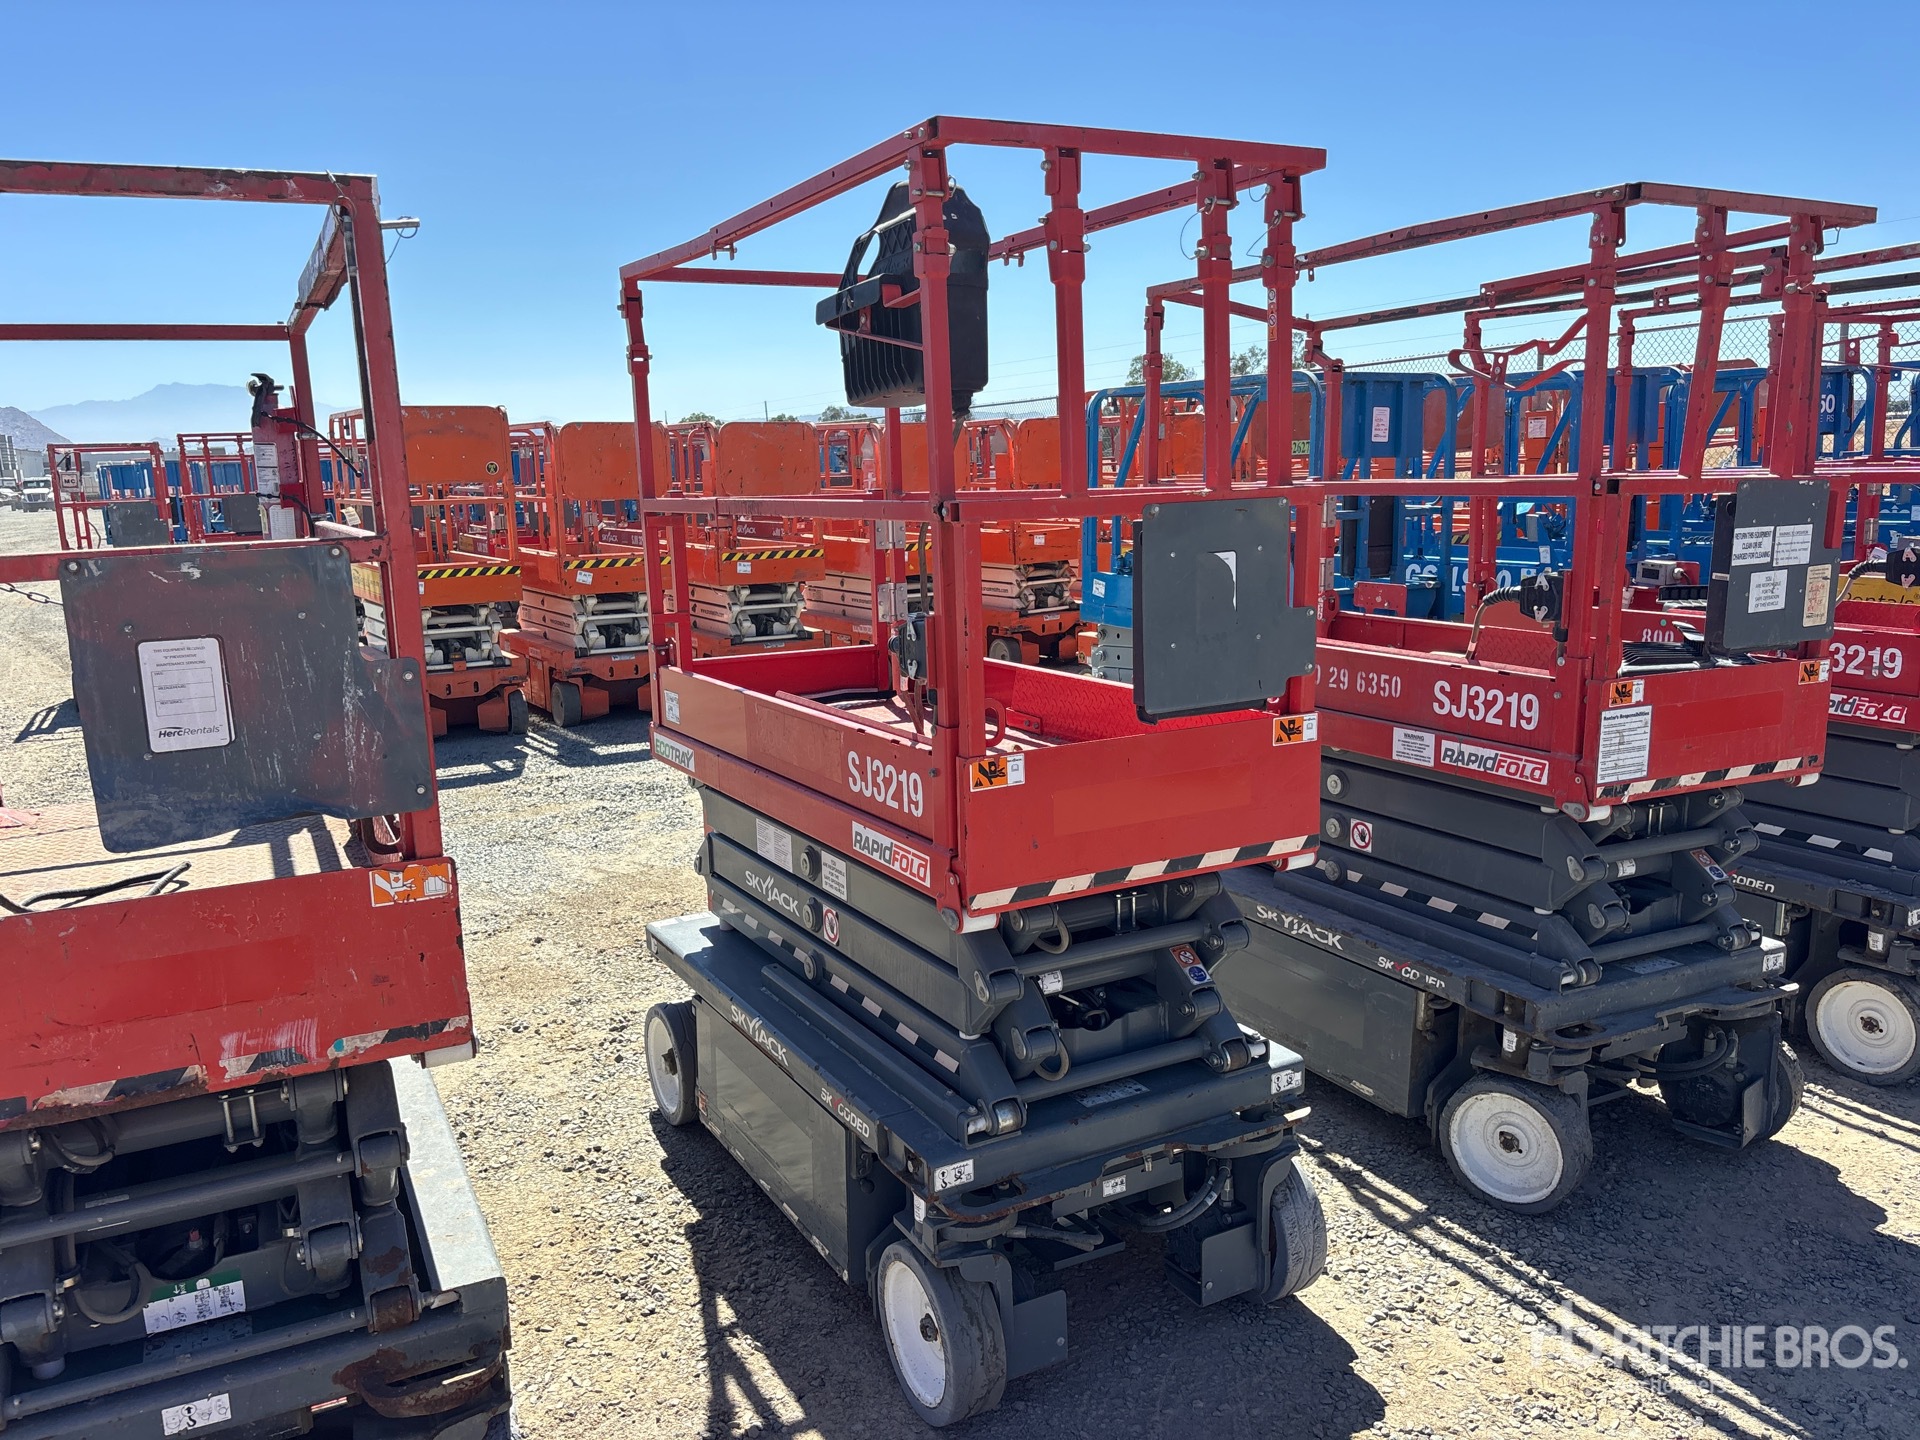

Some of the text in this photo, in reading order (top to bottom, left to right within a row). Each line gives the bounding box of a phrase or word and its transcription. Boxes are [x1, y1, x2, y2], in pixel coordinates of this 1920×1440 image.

[1328, 666, 1349, 691] 29
[1356, 670, 1402, 699] 6350
[1432, 680, 1540, 731] SJ3219
[656, 738, 694, 768] ECOTRAY
[847, 750, 924, 818] SJ3219
[745, 870, 800, 917] SKYJACK
[731, 1004, 789, 1067] SKYJACK
